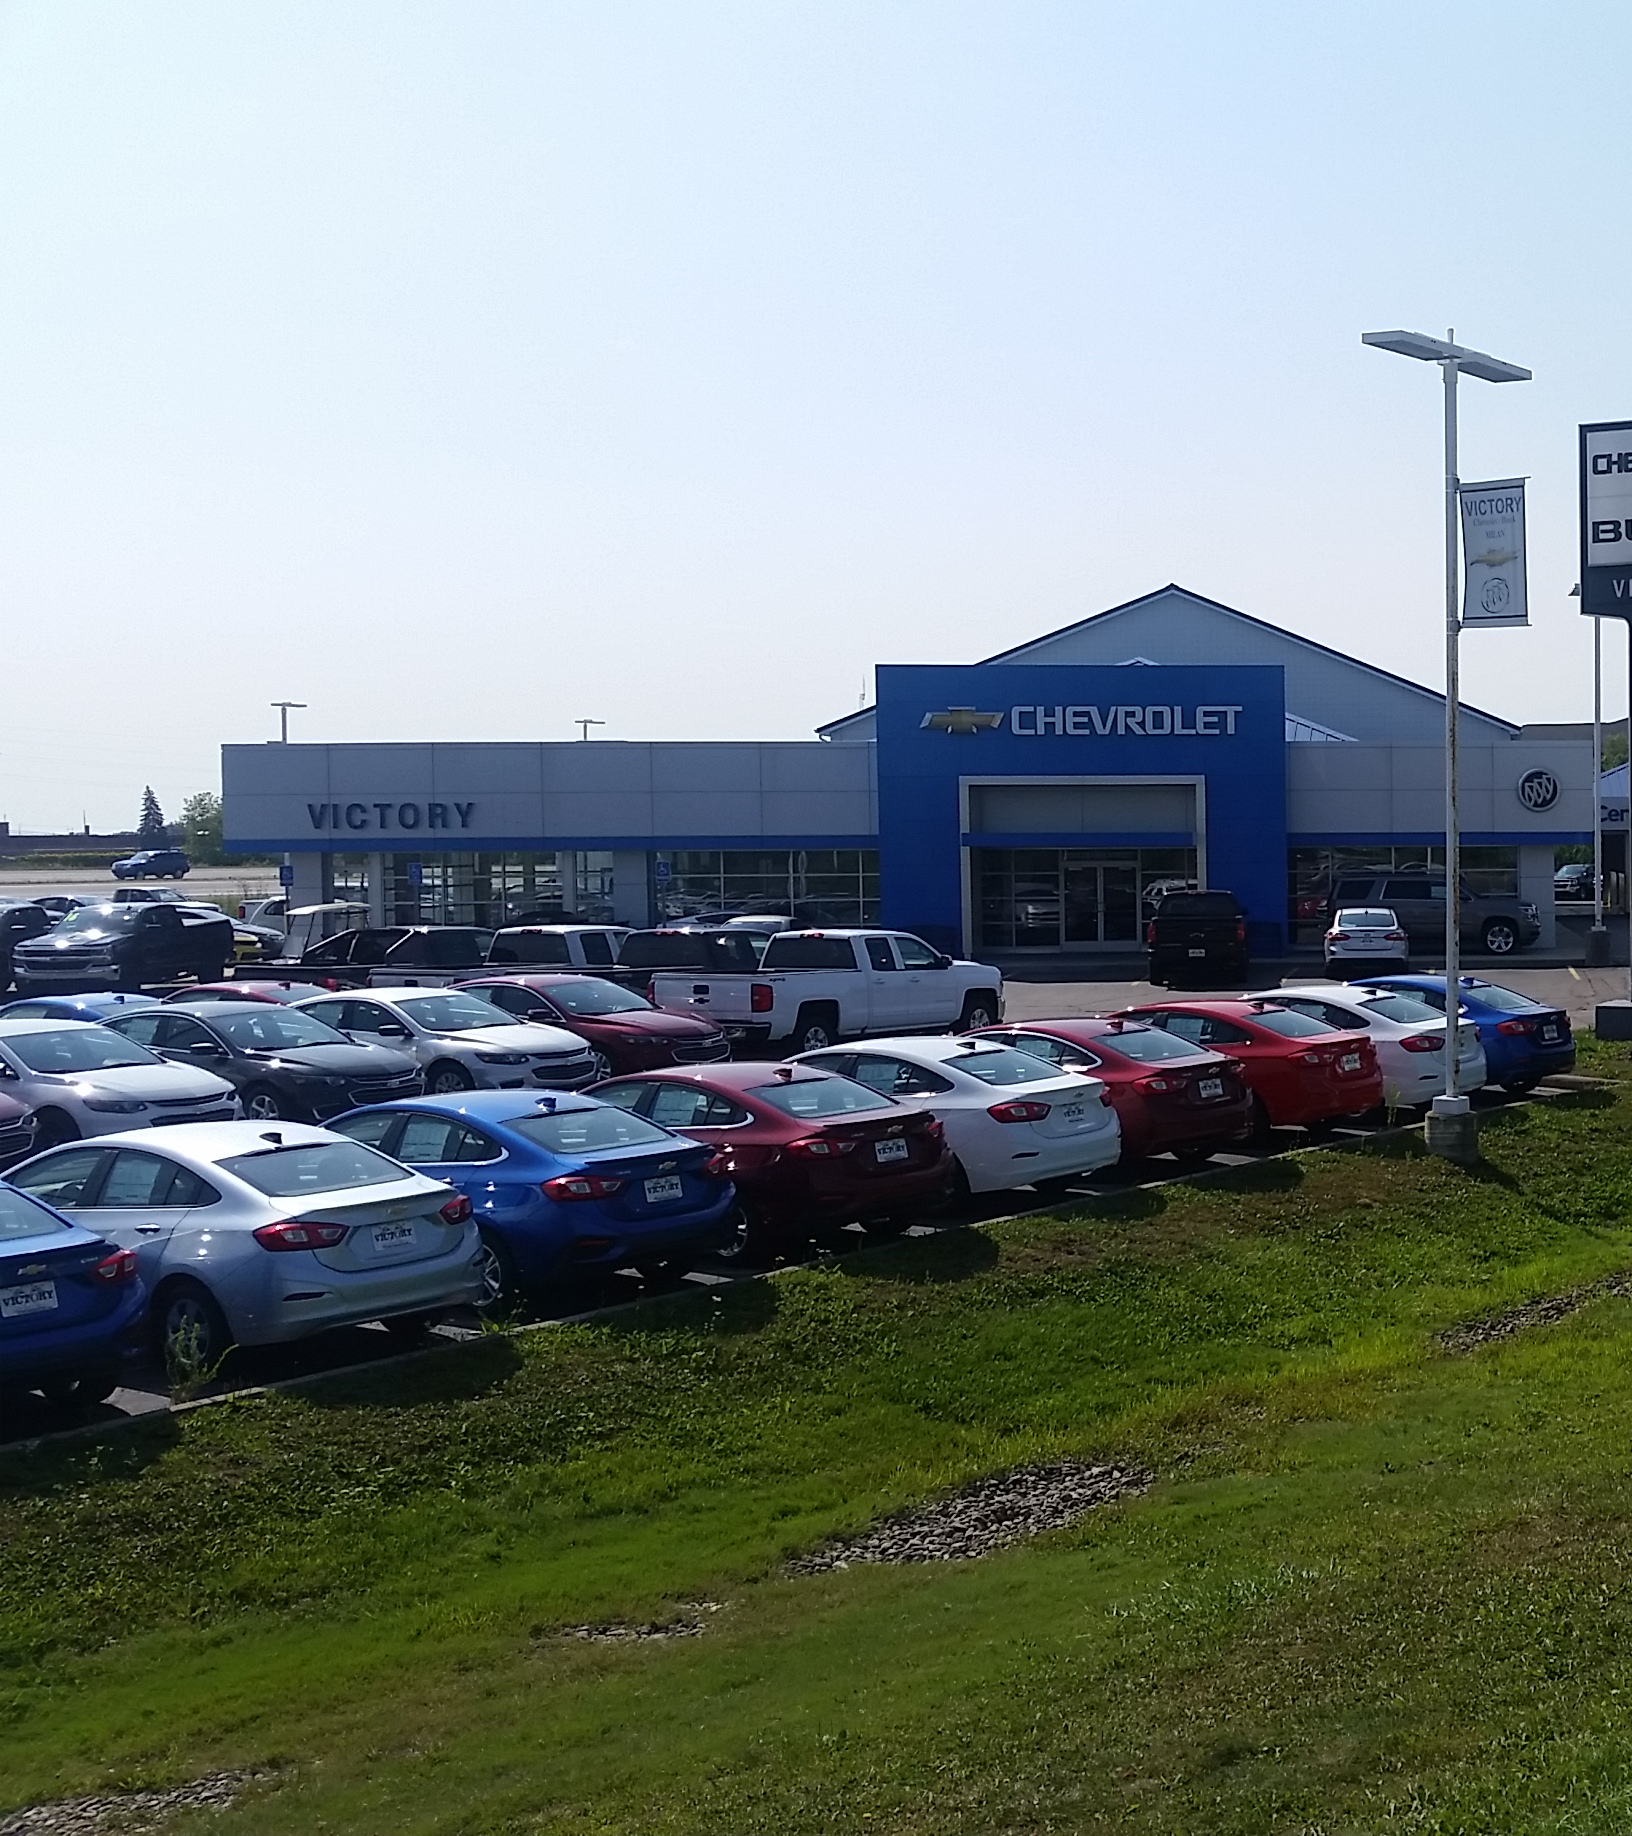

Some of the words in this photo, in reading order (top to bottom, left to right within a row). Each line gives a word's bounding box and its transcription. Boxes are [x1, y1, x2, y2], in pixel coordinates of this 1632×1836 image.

[1465, 496, 1522, 517] VICTORY
[1010, 705, 1244, 735] CHEVROLET
[307, 803, 475, 830] VICTORY
[374, 1228, 412, 1242] VICTORY
[2, 1290, 53, 1307] VICTORY
